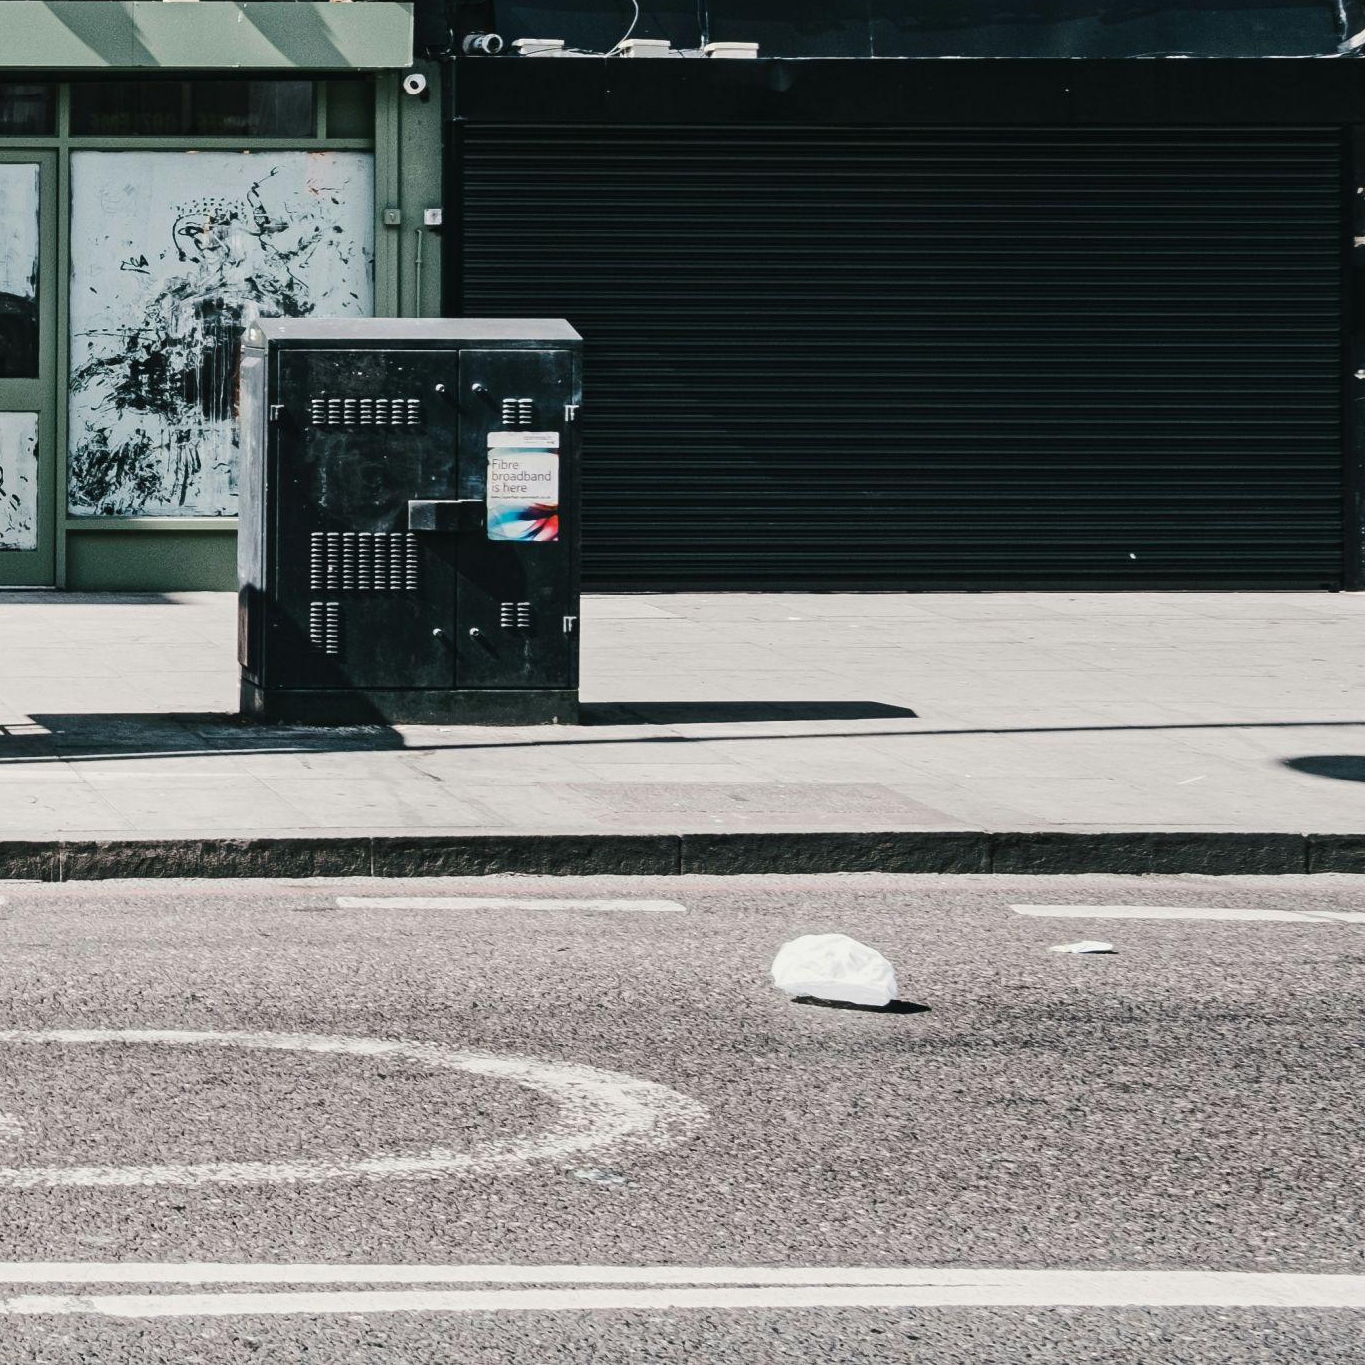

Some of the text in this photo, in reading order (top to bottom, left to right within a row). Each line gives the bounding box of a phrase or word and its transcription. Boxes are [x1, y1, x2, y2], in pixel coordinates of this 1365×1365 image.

[491, 458, 519, 470] Fibre
[491, 470, 552, 482] broadband
[491, 482, 528, 493] is here
